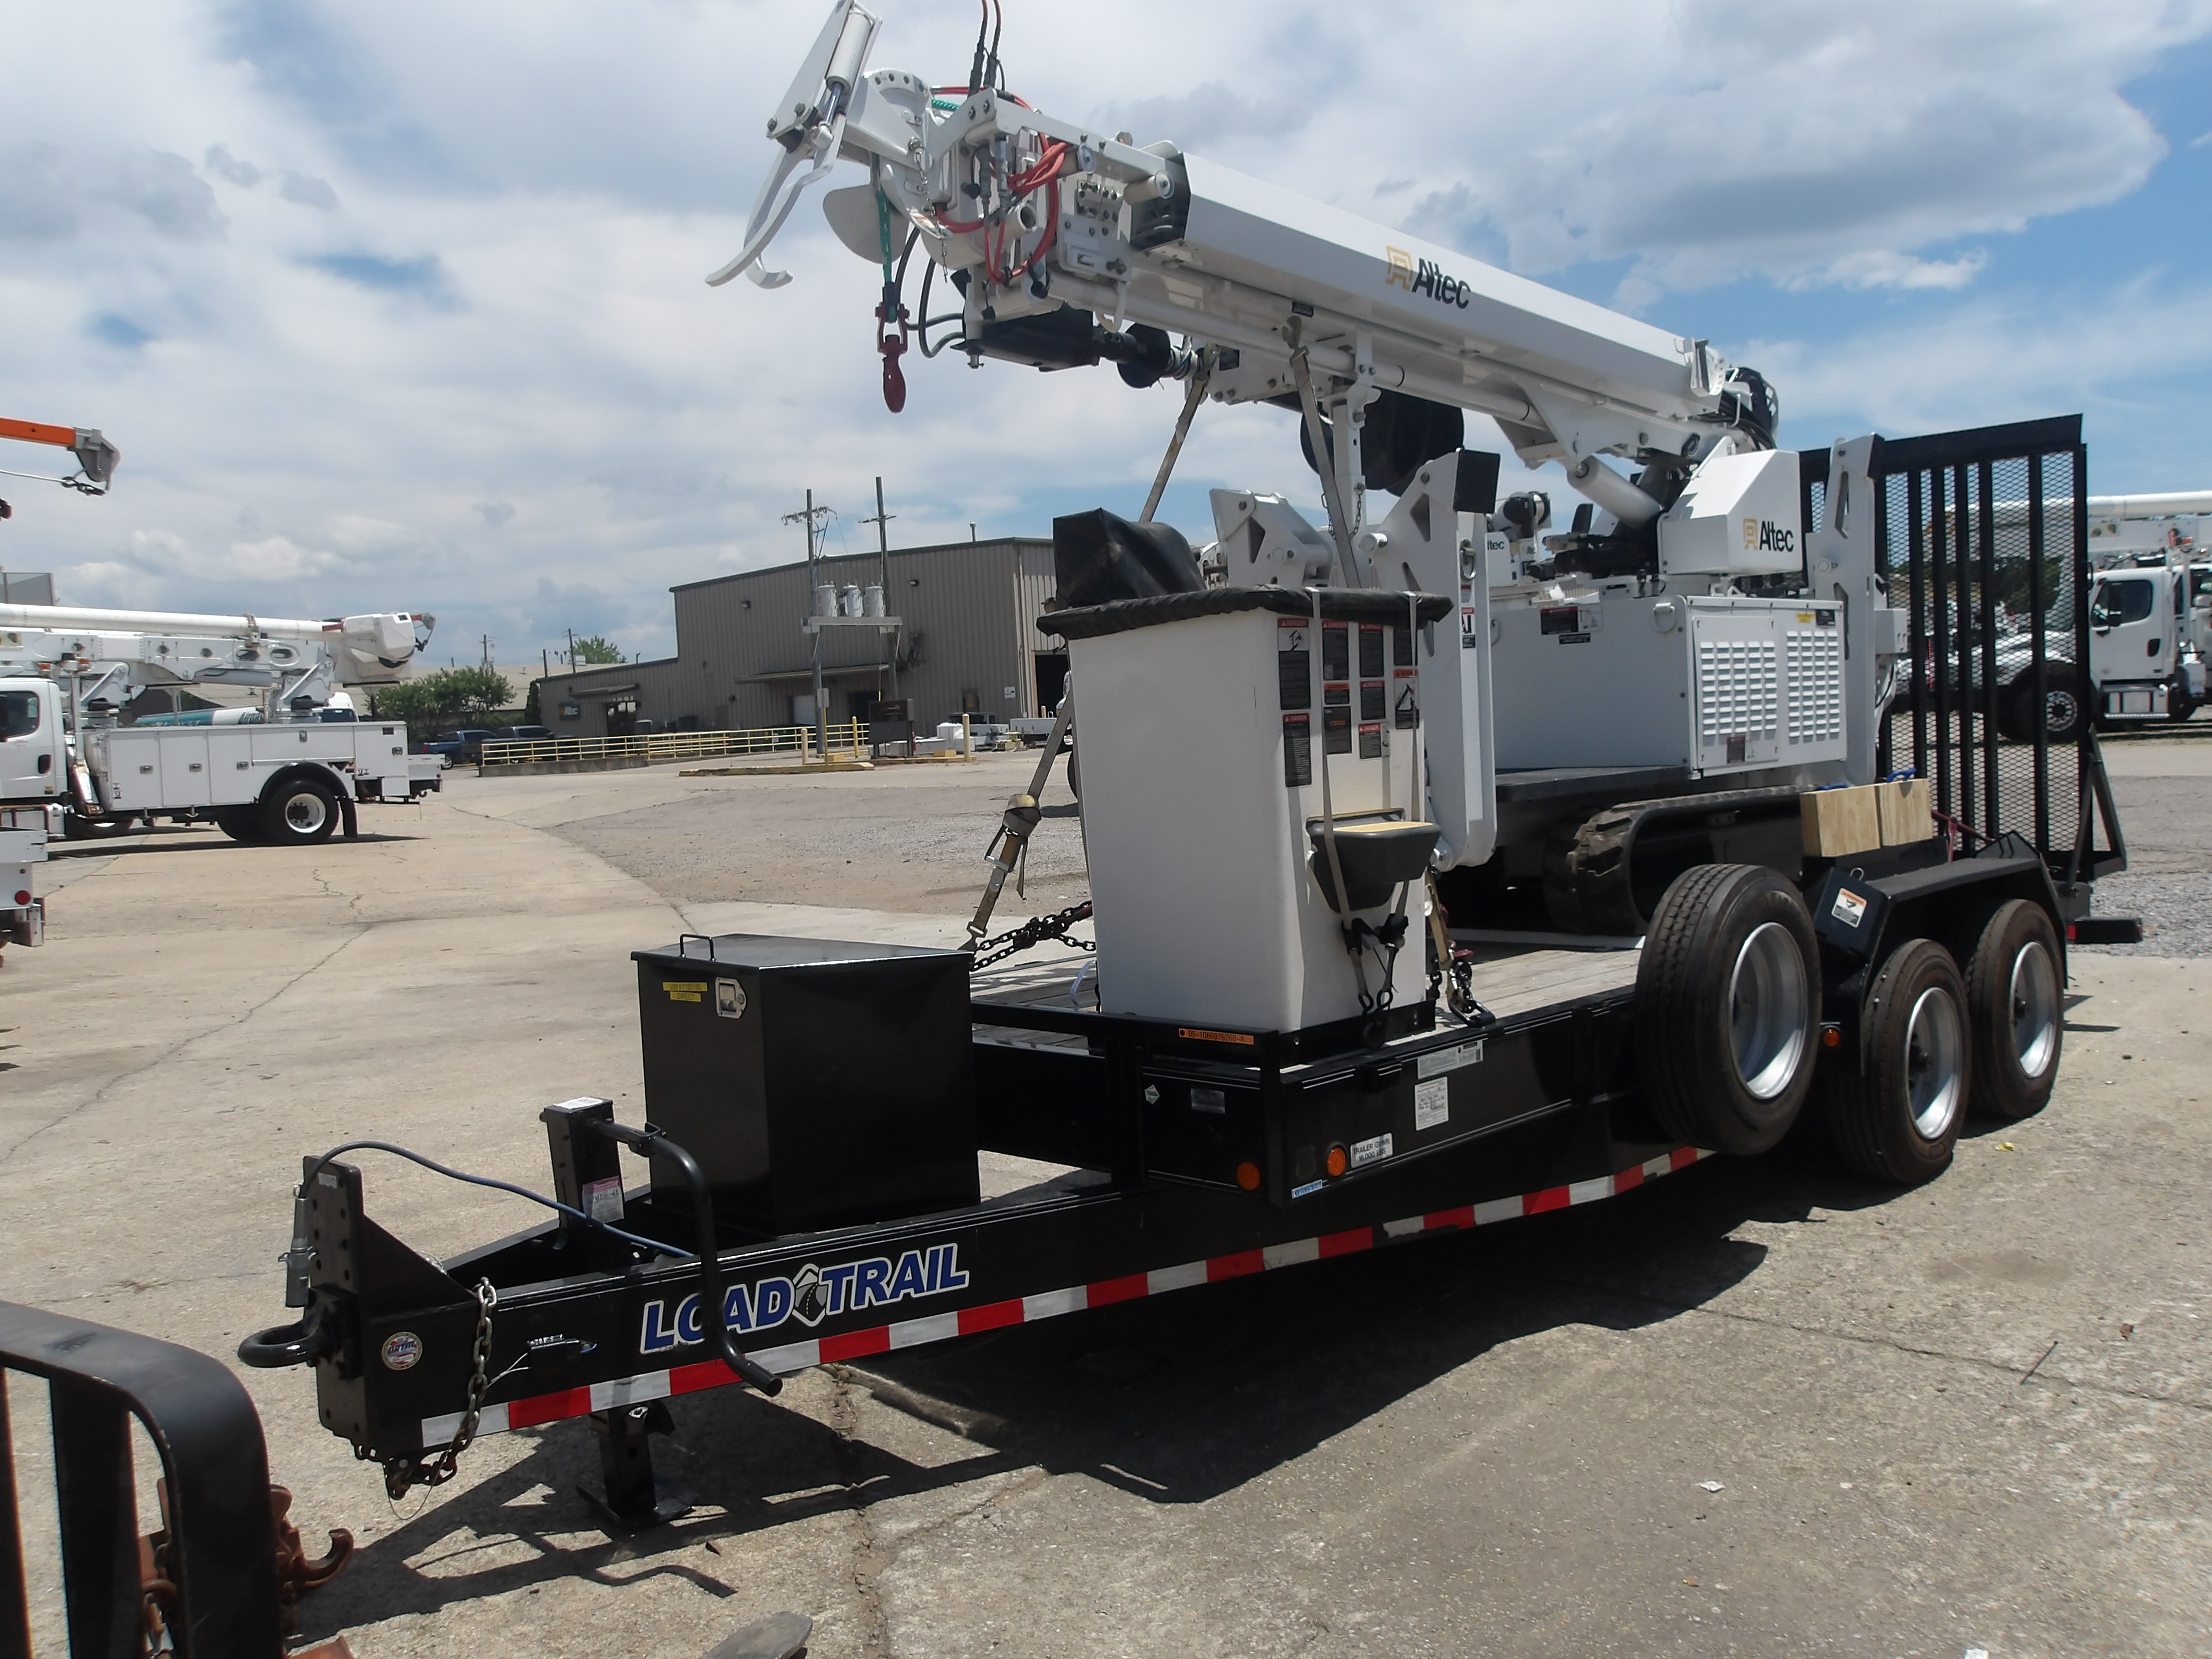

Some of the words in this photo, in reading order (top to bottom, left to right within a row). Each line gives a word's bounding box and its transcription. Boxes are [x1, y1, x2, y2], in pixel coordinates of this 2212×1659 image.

[1411, 258, 1472, 310] Altec
[1487, 540, 1505, 550] ltec
[1759, 520, 1794, 553] Altec
[1354, 1143, 1373, 1155] TRAILER
[1358, 1152, 1375, 1162] 16,000
[1376, 1148, 1386, 1156] LBS
[640, 1277, 795, 1354] LOAD
[817, 1242, 970, 1315] TRAIL
